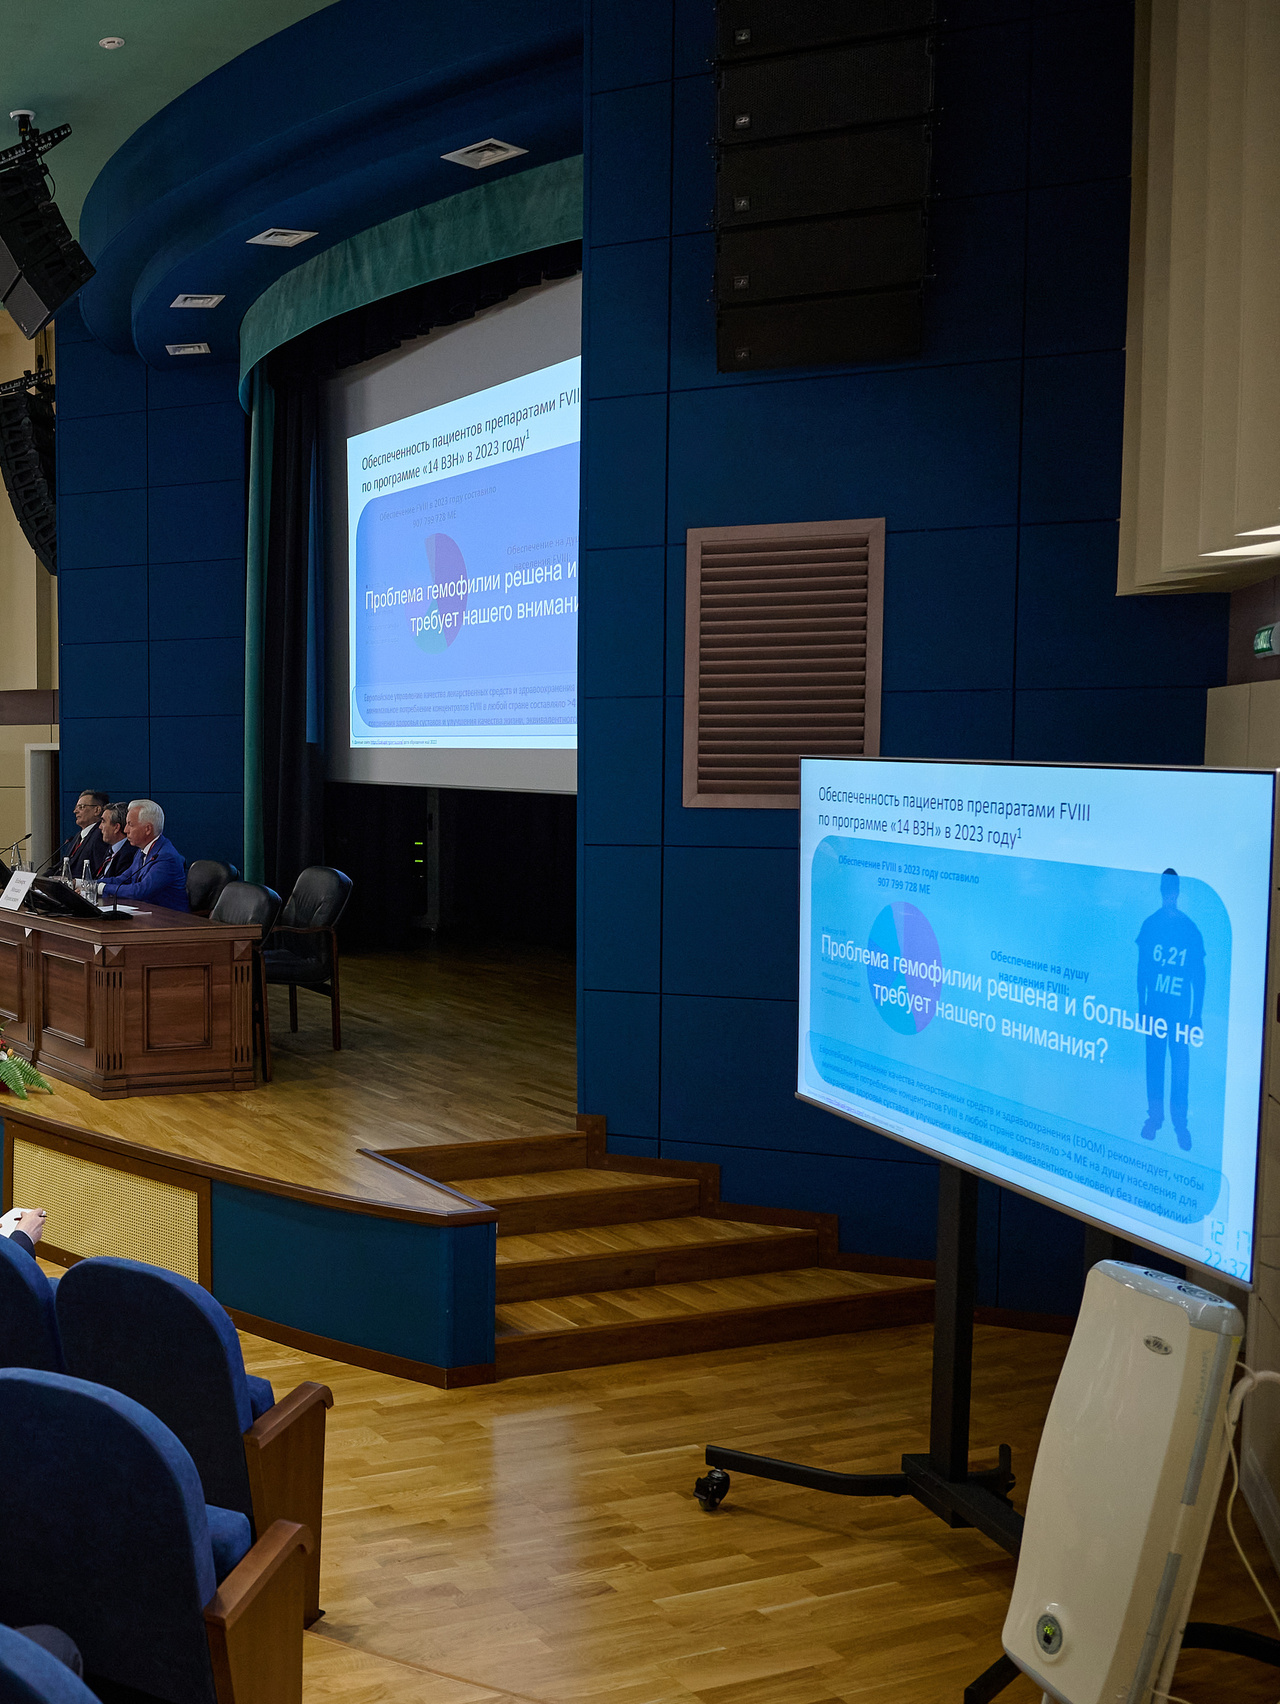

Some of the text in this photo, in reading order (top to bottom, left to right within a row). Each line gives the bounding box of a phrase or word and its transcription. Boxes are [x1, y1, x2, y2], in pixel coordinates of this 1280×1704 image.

[361, 387, 580, 471] Обеспеченность пациентов препаратами FVII
[361, 481, 372, 493] по
[373, 466, 421, 492] программе
[422, 458, 439, 475] «14
[441, 452, 465, 471] ВЗН»
[467, 450, 473, 463] в
[475, 439, 500, 461] 2023
[506, 540, 555, 555] Обеспечение
[555, 538, 564, 547] на
[365, 561, 577, 614] Проблема гемофилии решена и
[410, 609, 460, 637] требует
[462, 603, 513, 626] нашего
[818, 786, 1091, 822] Обеспеченность пациентов препаратами FVIII
[818, 814, 830, 827] по
[832, 815, 888, 833] программе
[890, 819, 910, 835] «14
[913, 820, 941, 837] ВЗН»
[944, 826, 952, 839] в
[954, 823, 984, 843] 2023
[838, 855, 881, 871] Обеспечение
[881, 860, 897, 873] FVIII
[904, 864, 920, 876] 2023
[921, 868, 939, 880] году
[940, 871, 980, 885] составило
[877, 877, 890, 888] 907
[891, 878, 904, 890] 799
[904, 881, 918, 893] 728
[990, 950, 1090, 984] Обеспечение на душу
[1153, 944, 1188, 967] 6,21
[821, 934, 889, 970] Проблема
[893, 955, 982, 993] гемофилии
[987, 977, 1058, 1013] решена
[1065, 995, 1077, 1017] и
[1083, 994, 1168, 1039] больше
[1175, 1022, 1205, 1048] не
[998, 972, 1045, 991] населения
[1154, 973, 1184, 997] МЕ
[873, 983, 931, 1015] требует
[936, 999, 996, 1033] нашего
[1001, 1017, 1109, 1064] внимания?
[964, 1113, 989, 1130] любой
[989, 1124, 1015, 1140] стране
[1015, 1134, 1060, 1157] составляло
[1073, 1152, 1089, 1168] МЕ
[1089, 1161, 1101, 1172] на
[1101, 1165, 1126, 1183] душу
[1126, 1174, 1177, 1201] населения
[1178, 1194, 1198, 1210] для
[966, 1099, 995, 1116] средств
[1002, 1111, 1071, 1143] здравоохранения
[1072, 1134, 1106, 1158] (EDQM)
[1107, 1149, 1172, 1181] рекомендует,
[1173, 1172, 1205, 1192] чтобы
[1074, 1173, 1115, 1198] человеку
[1115, 1187, 1132, 1204] без
[1203, 1248, 1249, 1280] 22:37
